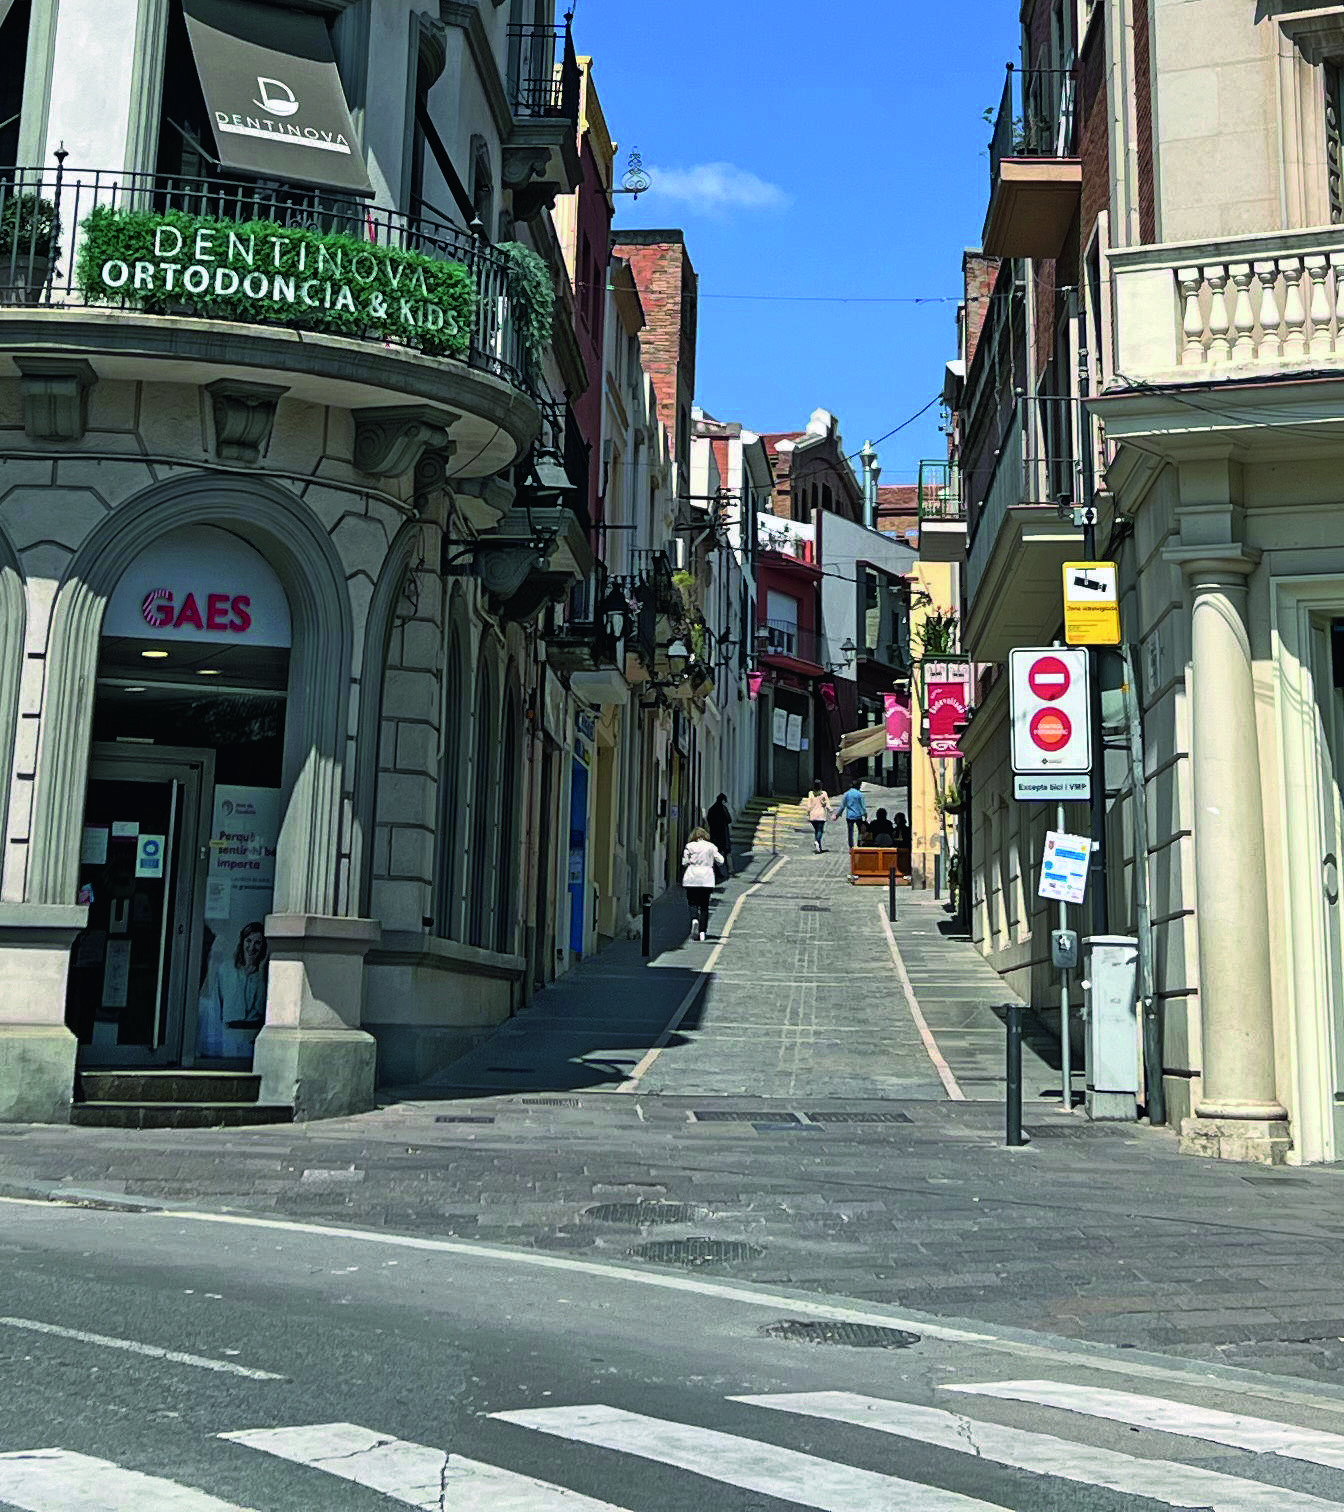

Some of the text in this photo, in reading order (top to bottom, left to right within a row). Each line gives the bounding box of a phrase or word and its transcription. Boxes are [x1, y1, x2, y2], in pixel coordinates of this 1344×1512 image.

[214, 111, 350, 146] DENTINOVA
[154, 225, 428, 297] DENTINOVA
[101, 259, 459, 336] ORTODONCIA & KIDS
[143, 589, 251, 632] GAES
[217, 859, 261, 871] importa
